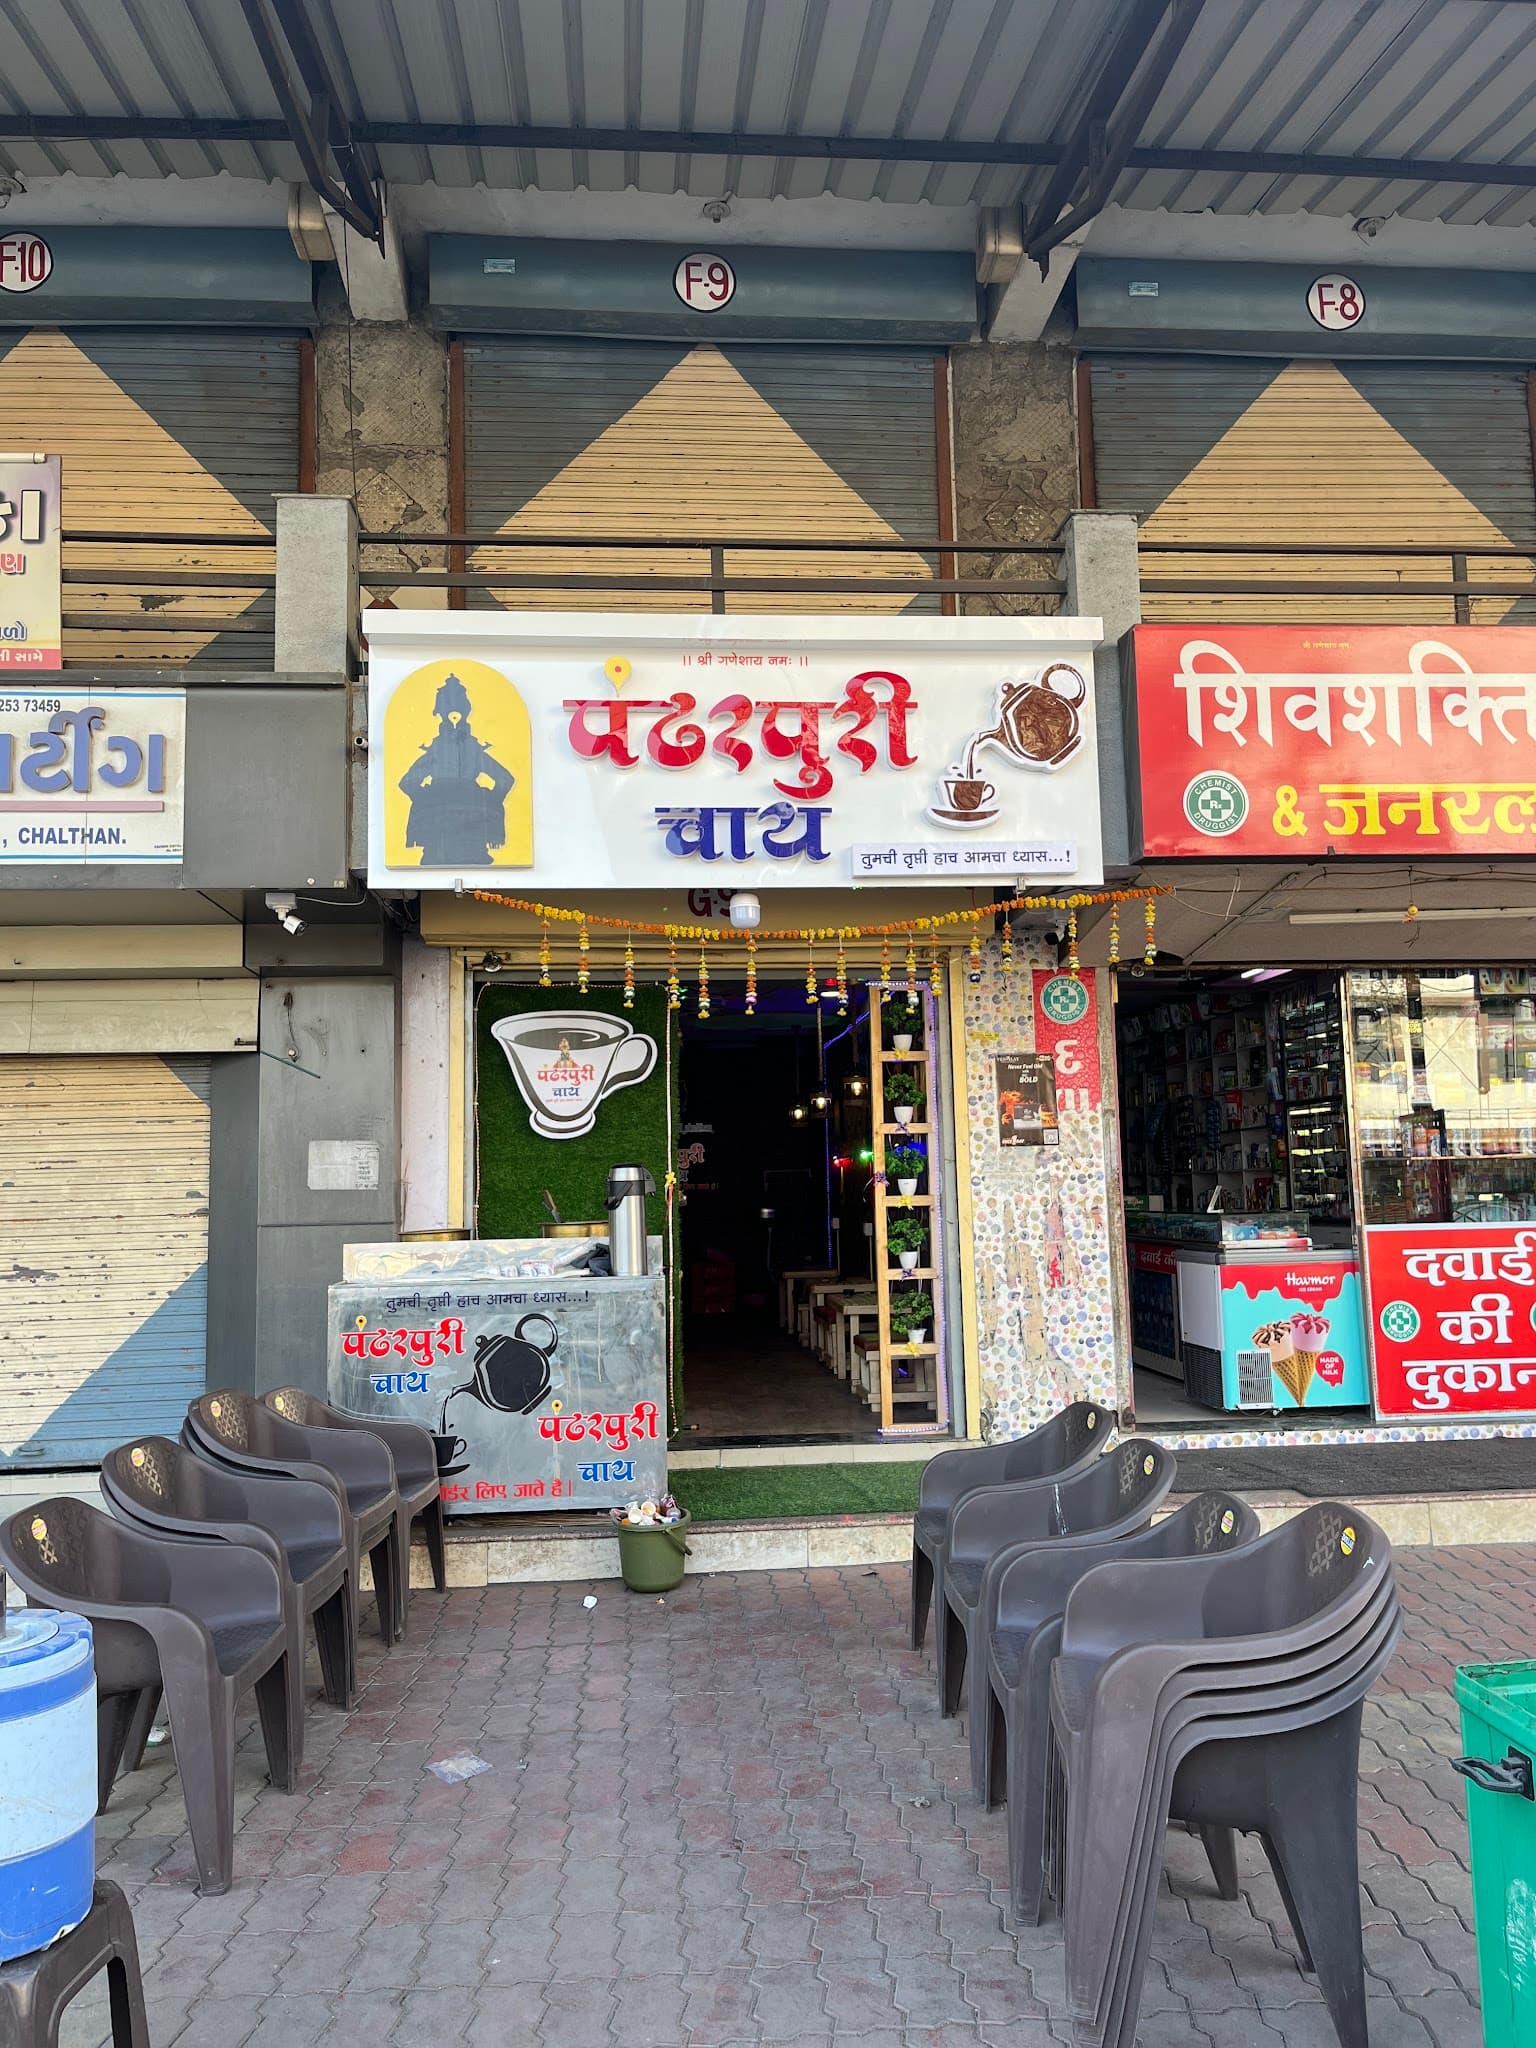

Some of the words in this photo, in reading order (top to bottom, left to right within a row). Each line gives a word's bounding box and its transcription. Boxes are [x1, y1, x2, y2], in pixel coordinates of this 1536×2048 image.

[697, 652, 712, 666] श्री
[718, 652, 763, 666] गणेशाय
[24, 700, 61, 712] 73459
[1194, 779, 1238, 795] CHEMIST
[1193, 811, 1239, 830] DRUGGIST
[1273, 785, 1308, 836] &
[18, 827, 127, 845] CHALTHAN.
[861, 849, 897, 869] तुमची
[933, 852, 958, 866] हाच
[964, 851, 1006, 864] आमचा
[1402, 1231, 1536, 1286] दवाई
[1284, 1271, 1336, 1286] Havmor
[385, 1292, 421, 1313] तुमची
[456, 1295, 480, 1308] हाच
[486, 1292, 527, 1305] आमचा
[1436, 1293, 1513, 1344] की
[341, 1317, 466, 1367] पंढरपुरी
[537, 1401, 661, 1452] पंढरपुरी
[475, 1481, 508, 1500] लिए
[513, 1479, 545, 1497] जाते
